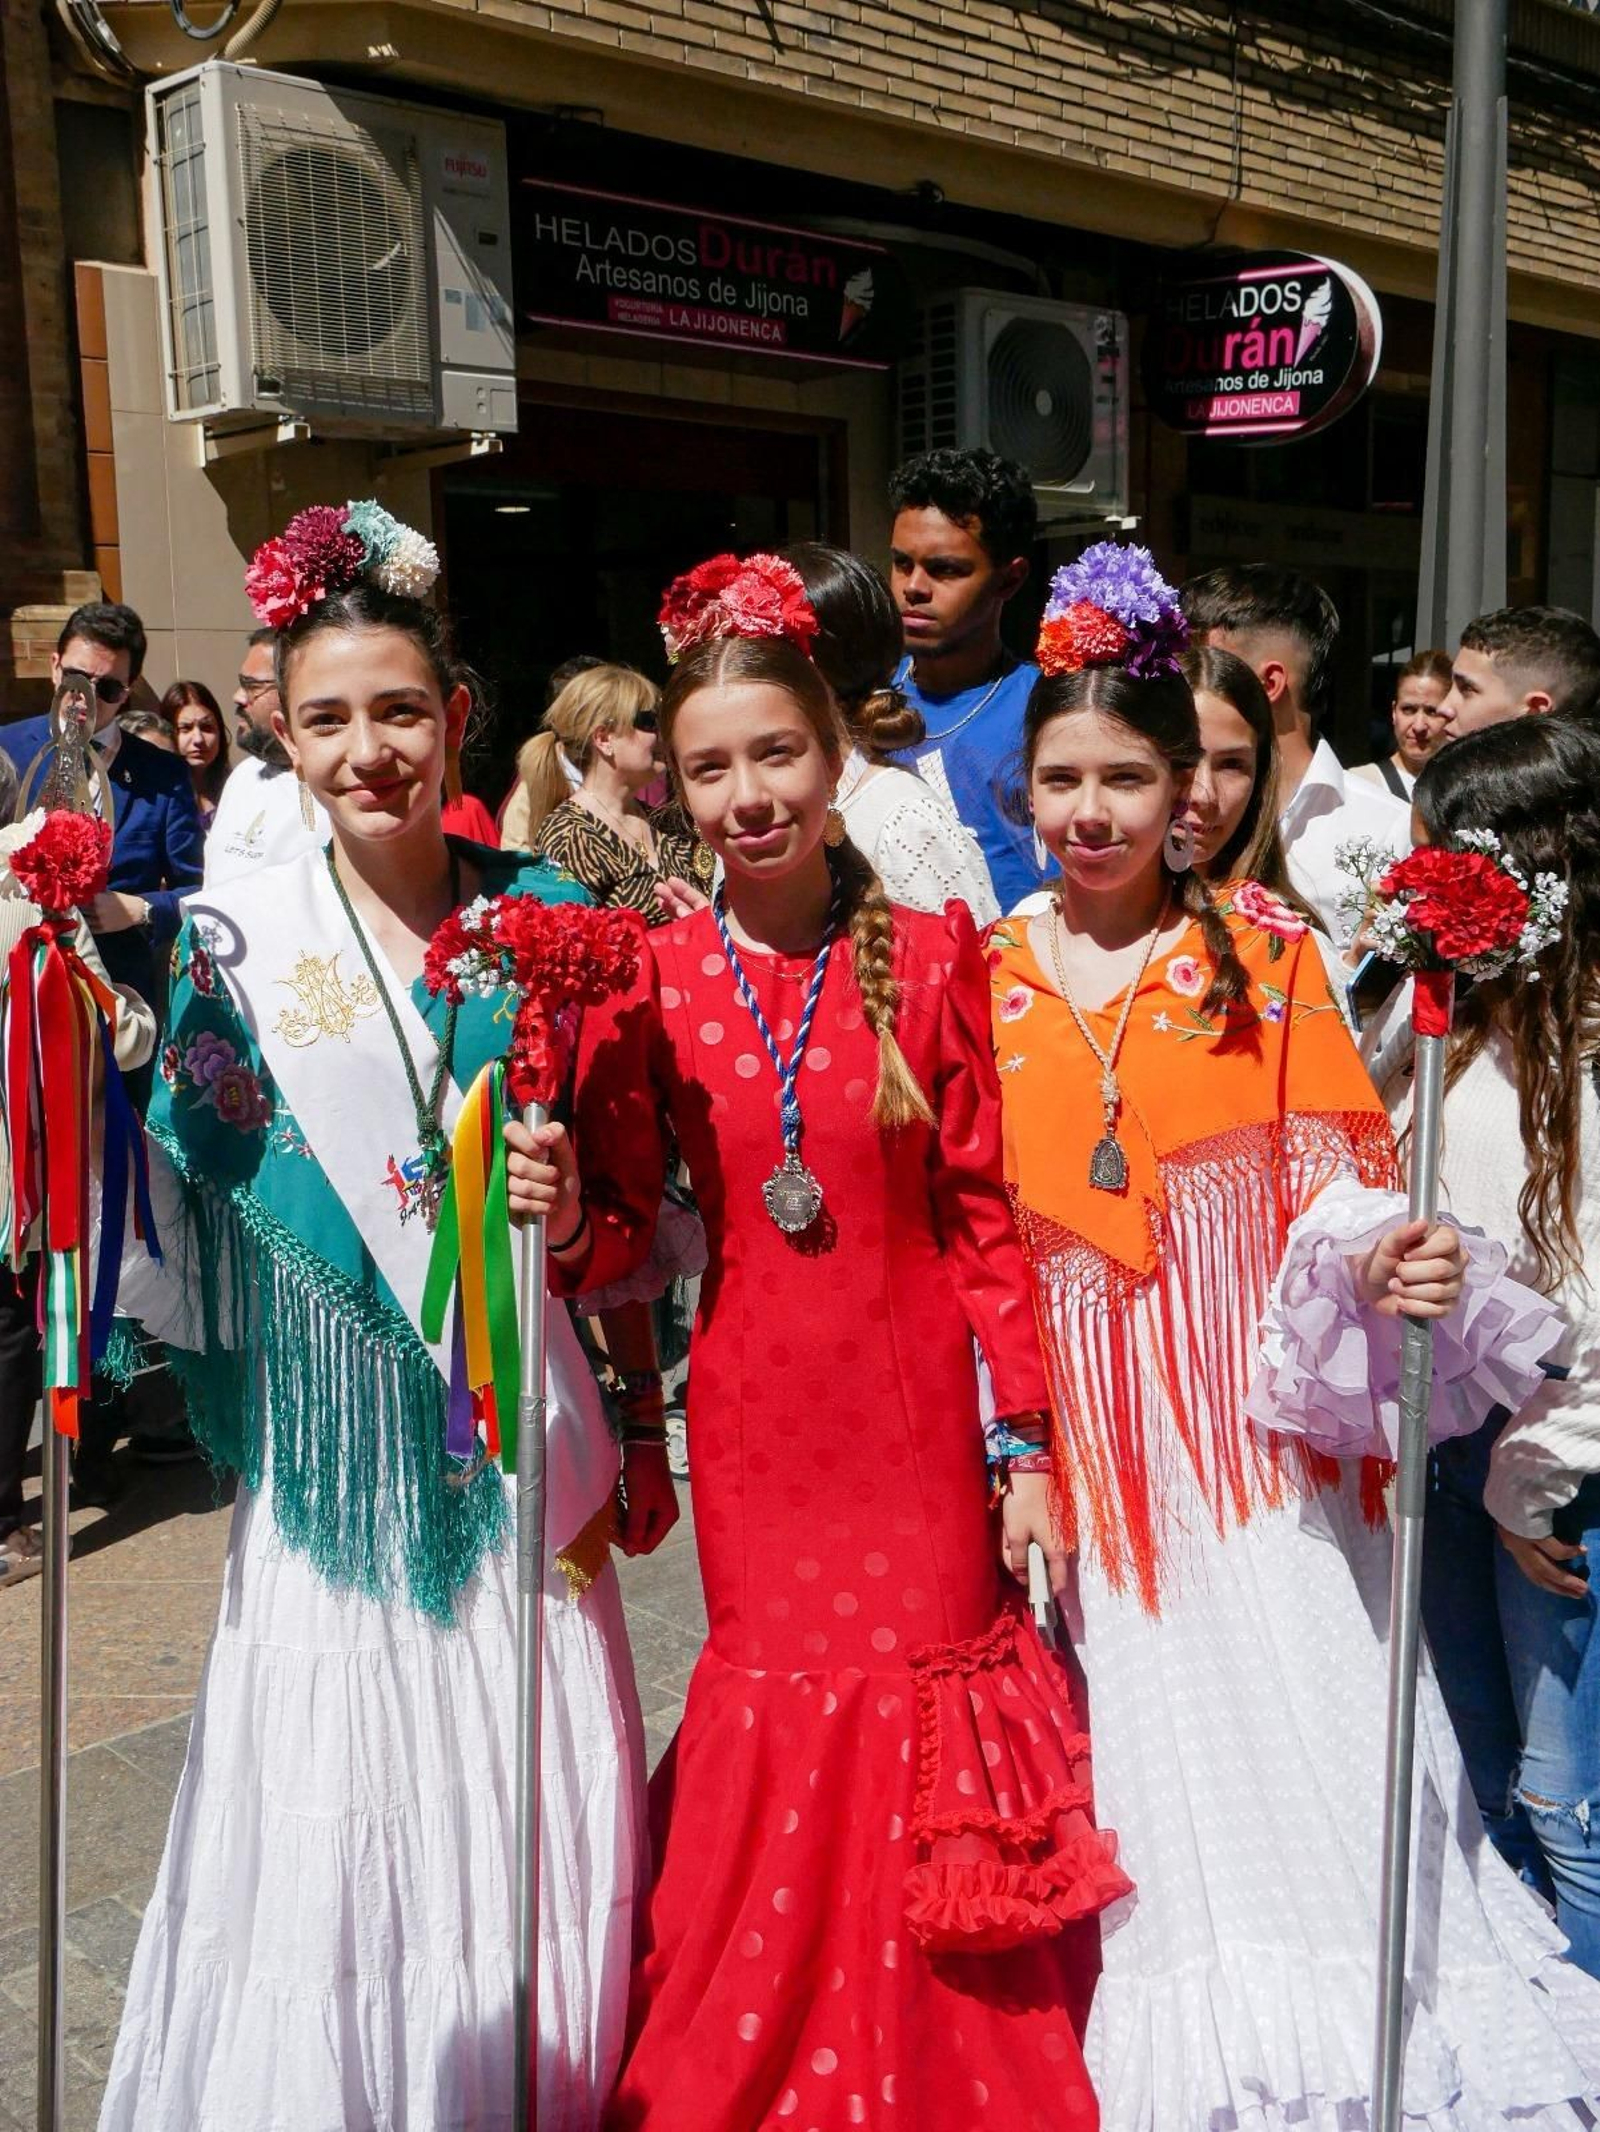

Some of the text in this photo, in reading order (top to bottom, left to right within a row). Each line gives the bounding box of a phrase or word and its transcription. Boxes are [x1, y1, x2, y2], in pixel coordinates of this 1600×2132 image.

[534, 212, 838, 289] HELADOS Durán
[575, 252, 808, 317] Artesanos de Jijona
[1164, 280, 1302, 321] HELADOS
[668, 308, 782, 342] LA JIJONENCA
[1162, 315, 1296, 374] Durán
[1163, 367, 1324, 394] Artesanos de Jijona
[1187, 396, 1294, 419] LA JIJONENCA
